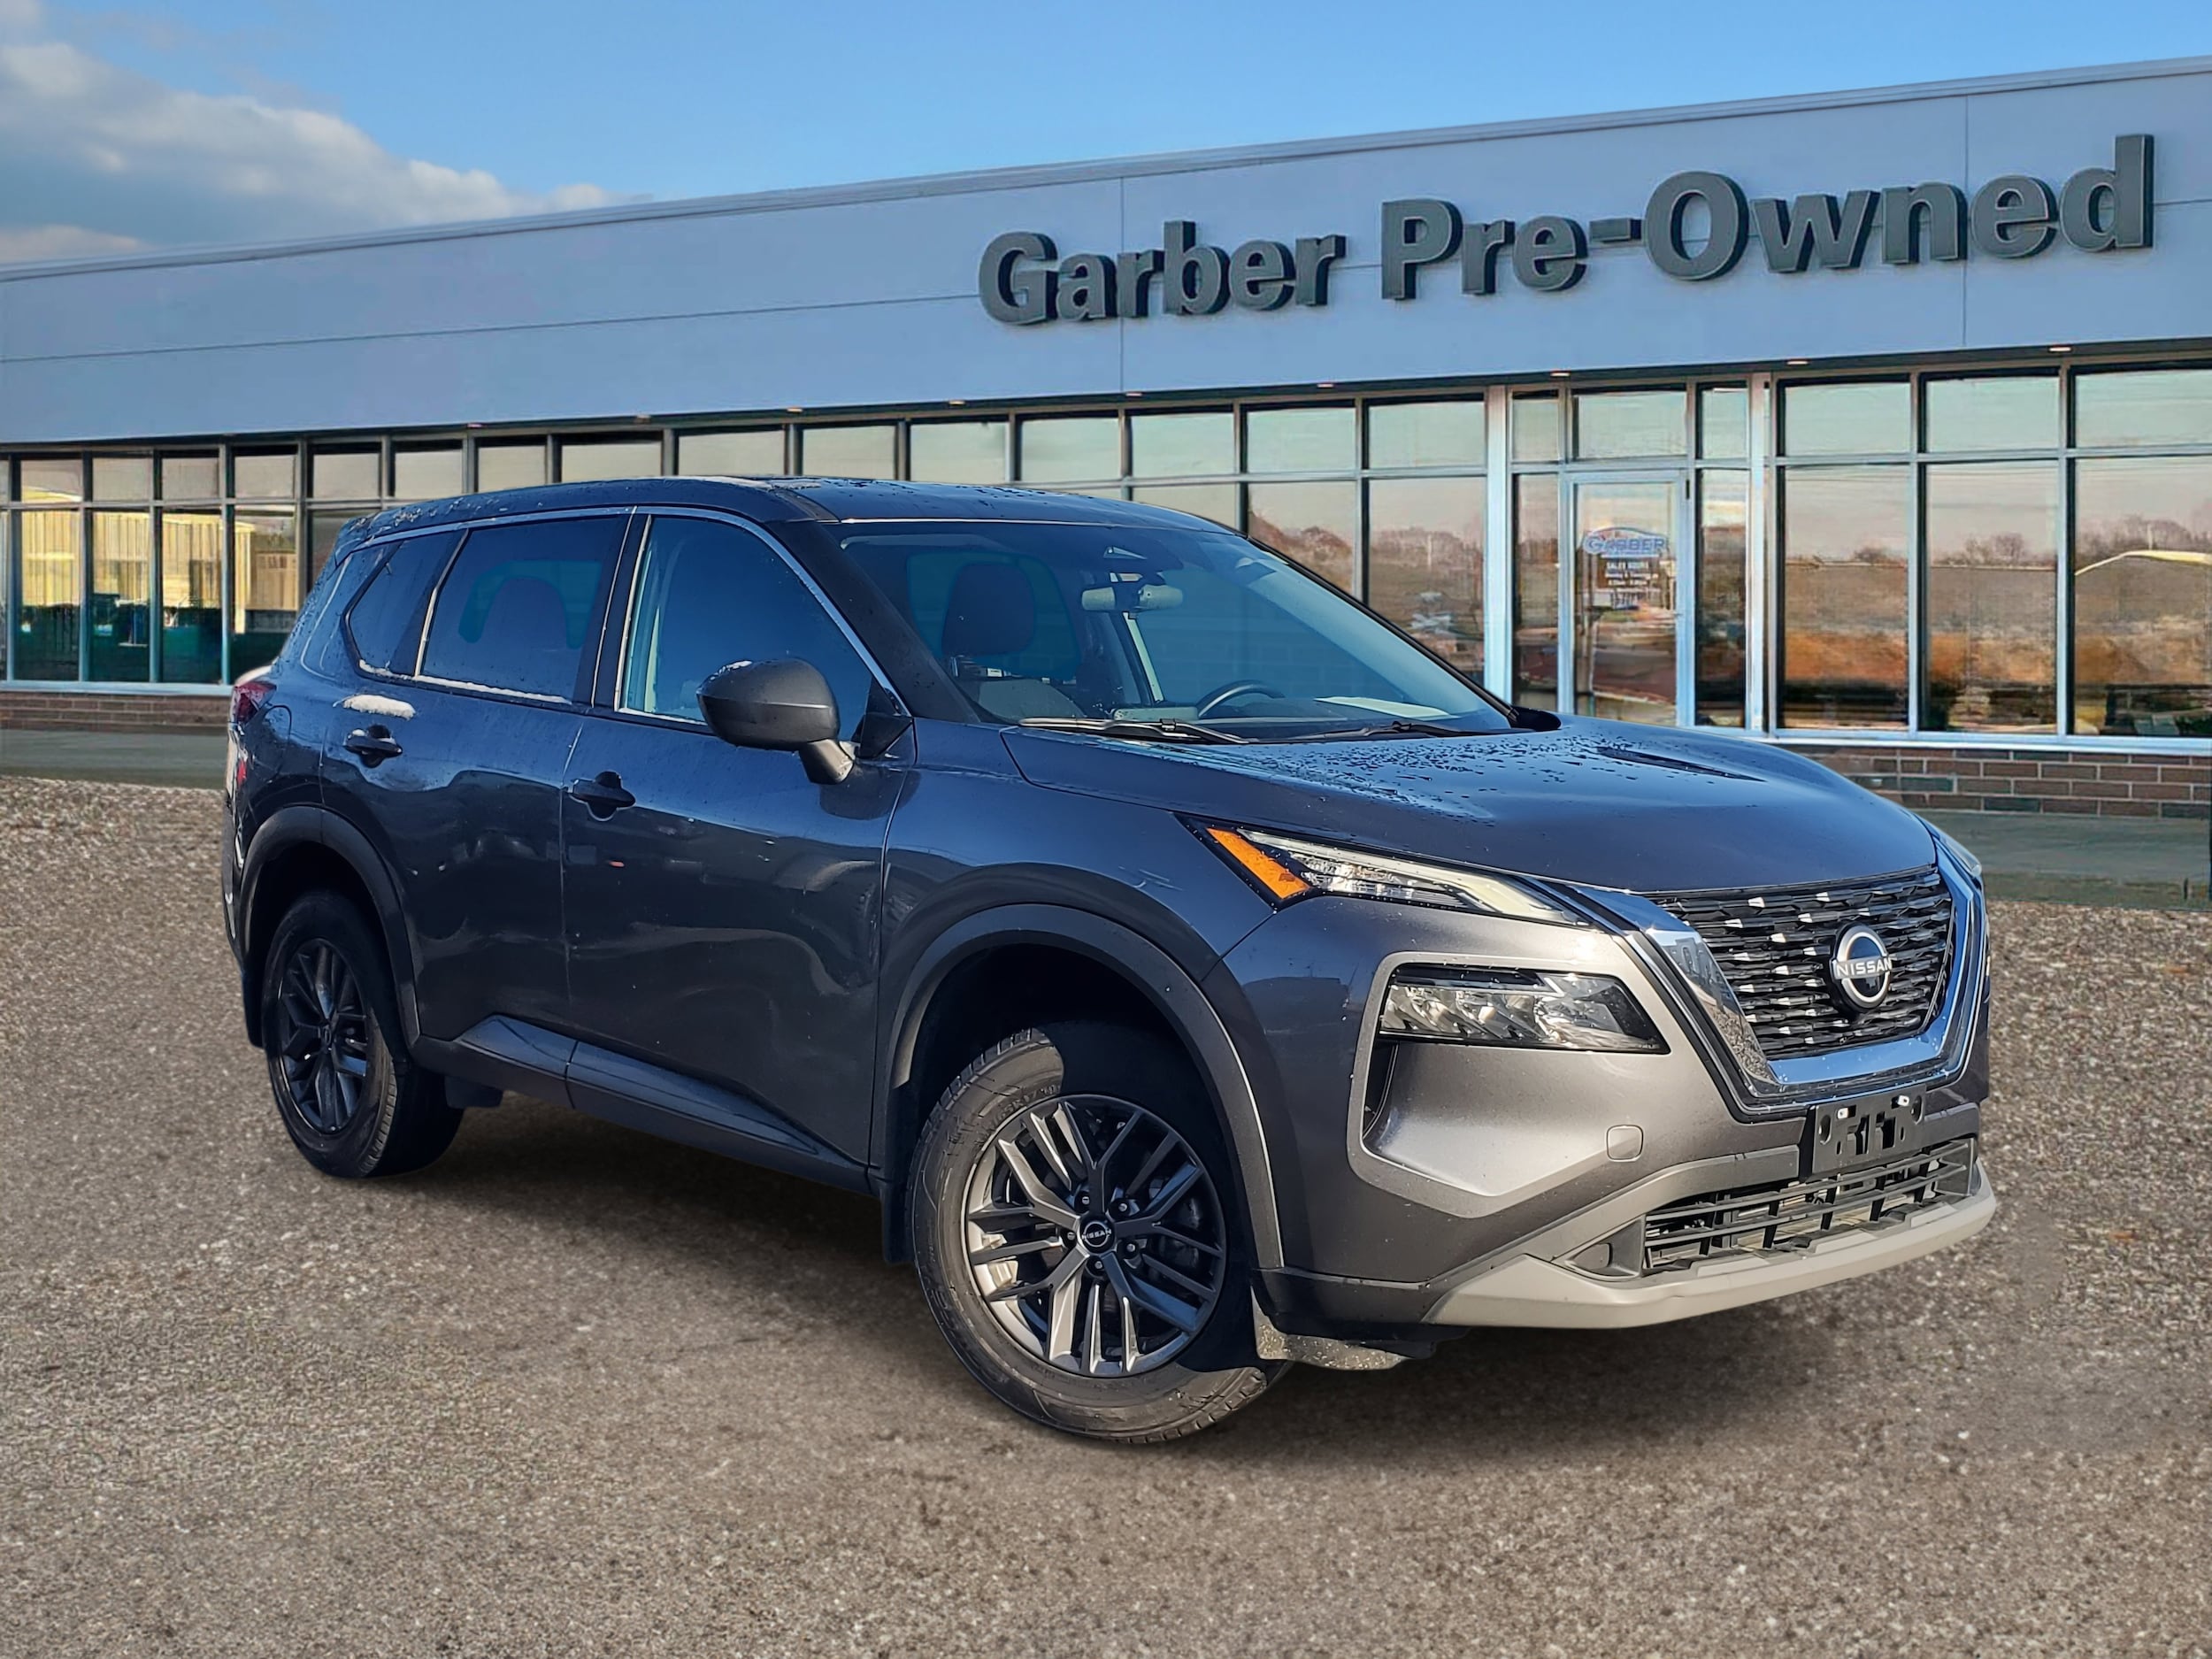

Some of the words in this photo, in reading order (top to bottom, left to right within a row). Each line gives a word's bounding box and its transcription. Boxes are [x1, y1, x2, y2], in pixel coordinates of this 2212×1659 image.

[979, 220, 1347, 325] Garber
[1381, 134, 2154, 299] Pre-Owned
[1586, 536, 1665, 552] GARBER
[1836, 956, 1893, 977] NISSAN
